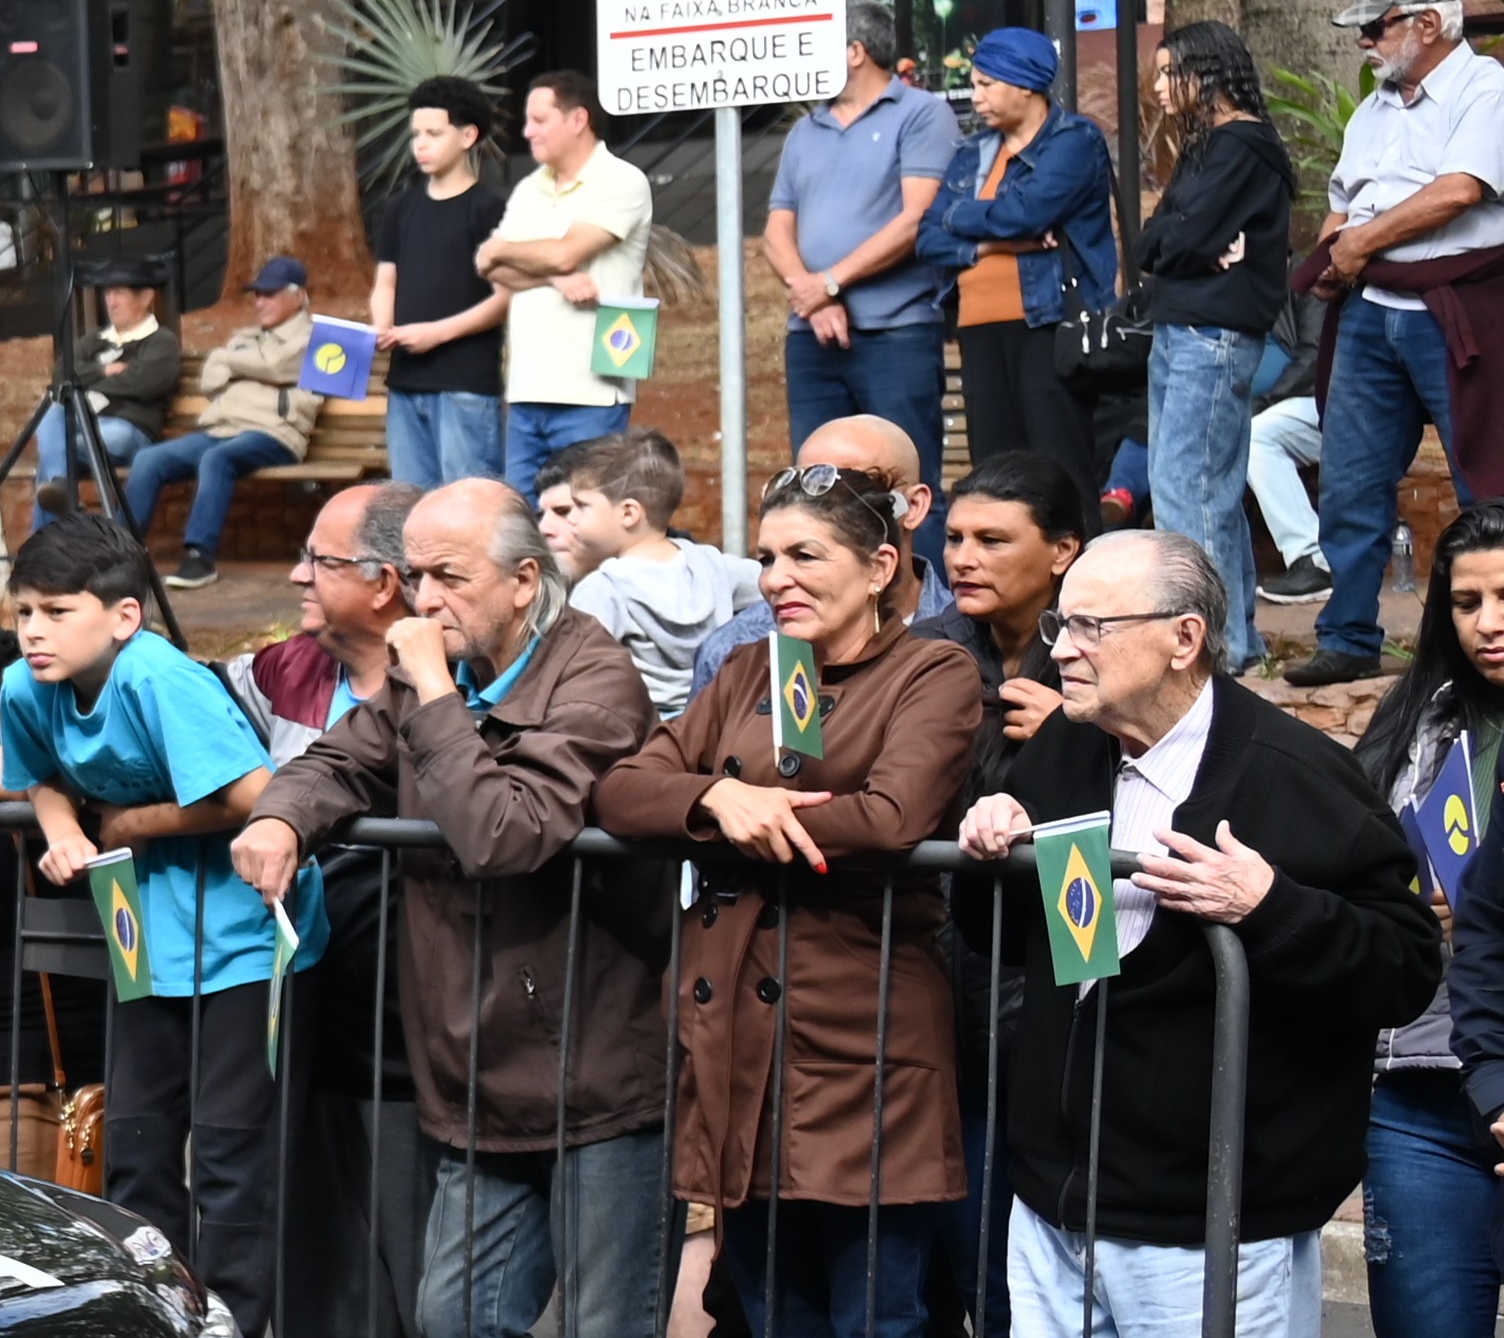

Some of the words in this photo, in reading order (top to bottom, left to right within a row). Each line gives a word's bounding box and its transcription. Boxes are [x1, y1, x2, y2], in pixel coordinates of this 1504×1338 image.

[624, 3, 652, 24] NA
[631, 34, 788, 72] EMBARQUE
[798, 31, 814, 57] E
[617, 70, 831, 112] DESEMBARQUE
